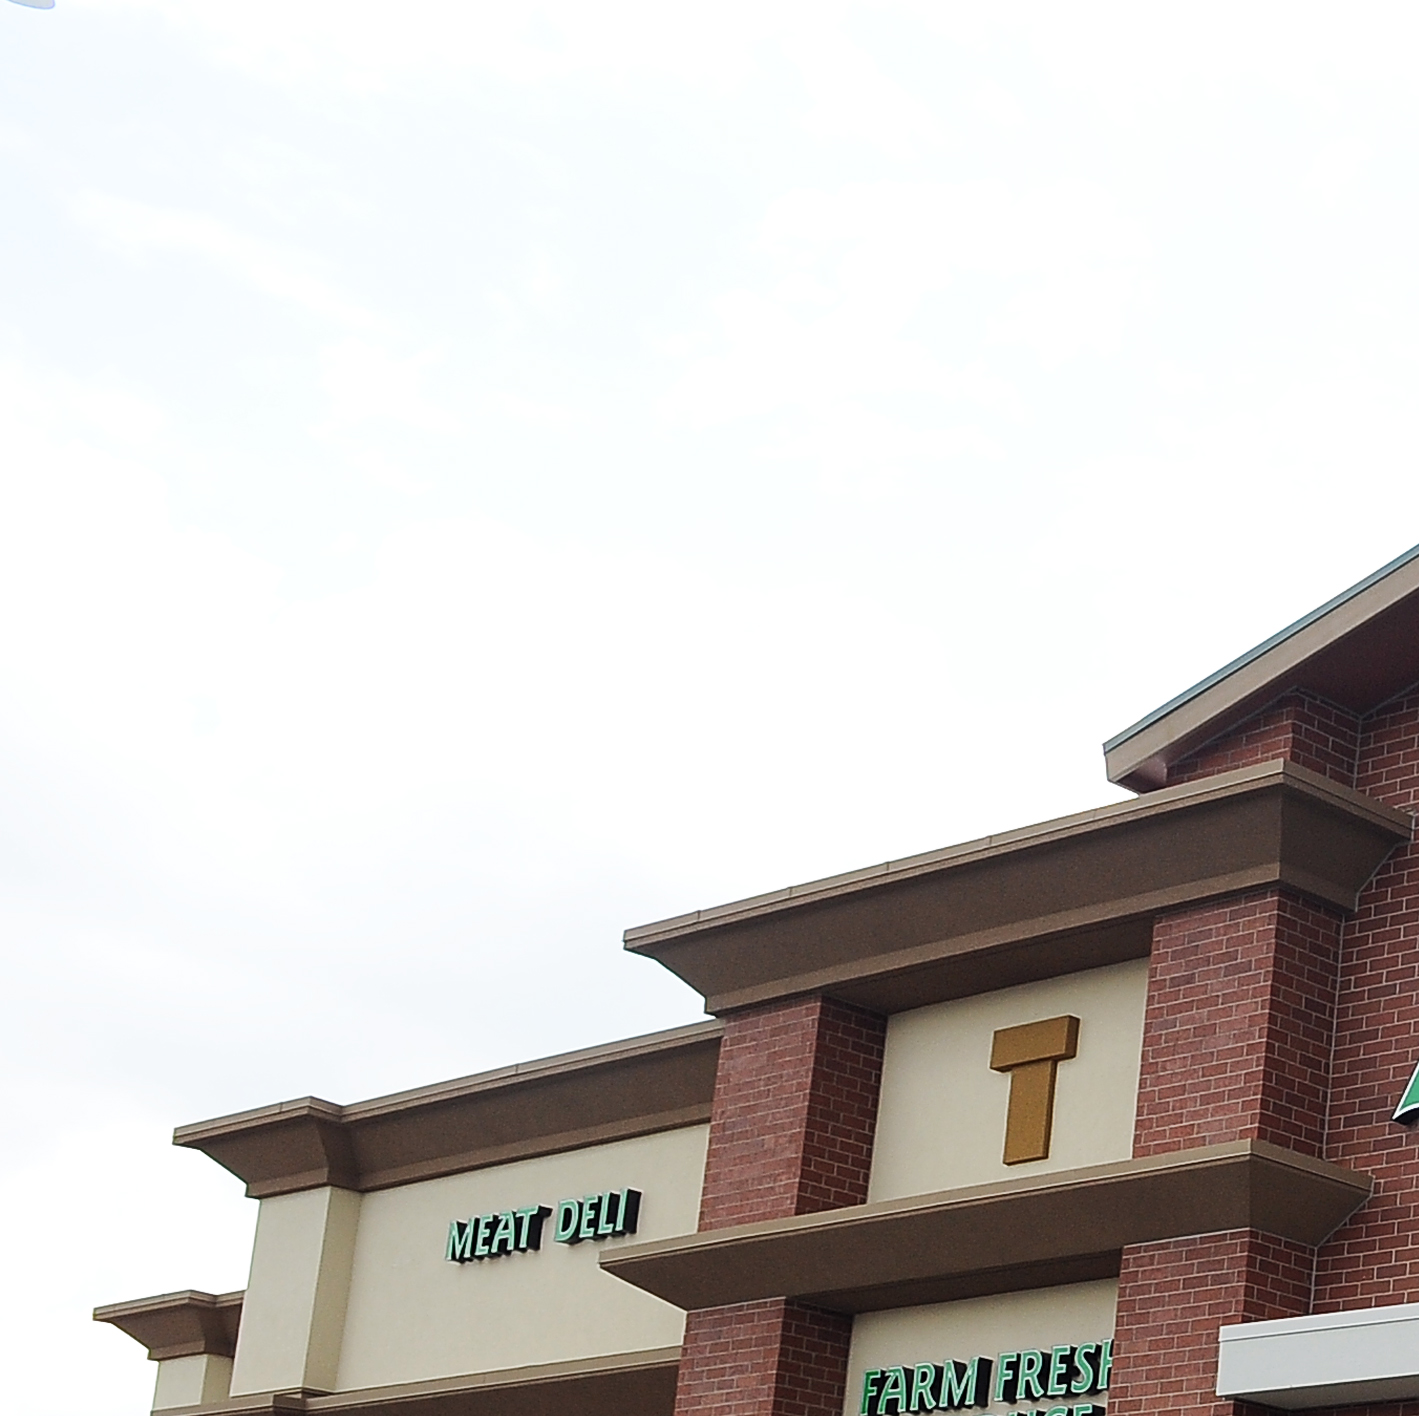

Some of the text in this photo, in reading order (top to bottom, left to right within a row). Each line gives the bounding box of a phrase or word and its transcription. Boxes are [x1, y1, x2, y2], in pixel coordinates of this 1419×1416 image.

[446, 1186, 629, 1261] MEAT DELI
[860, 1356, 980, 1416] FARM
